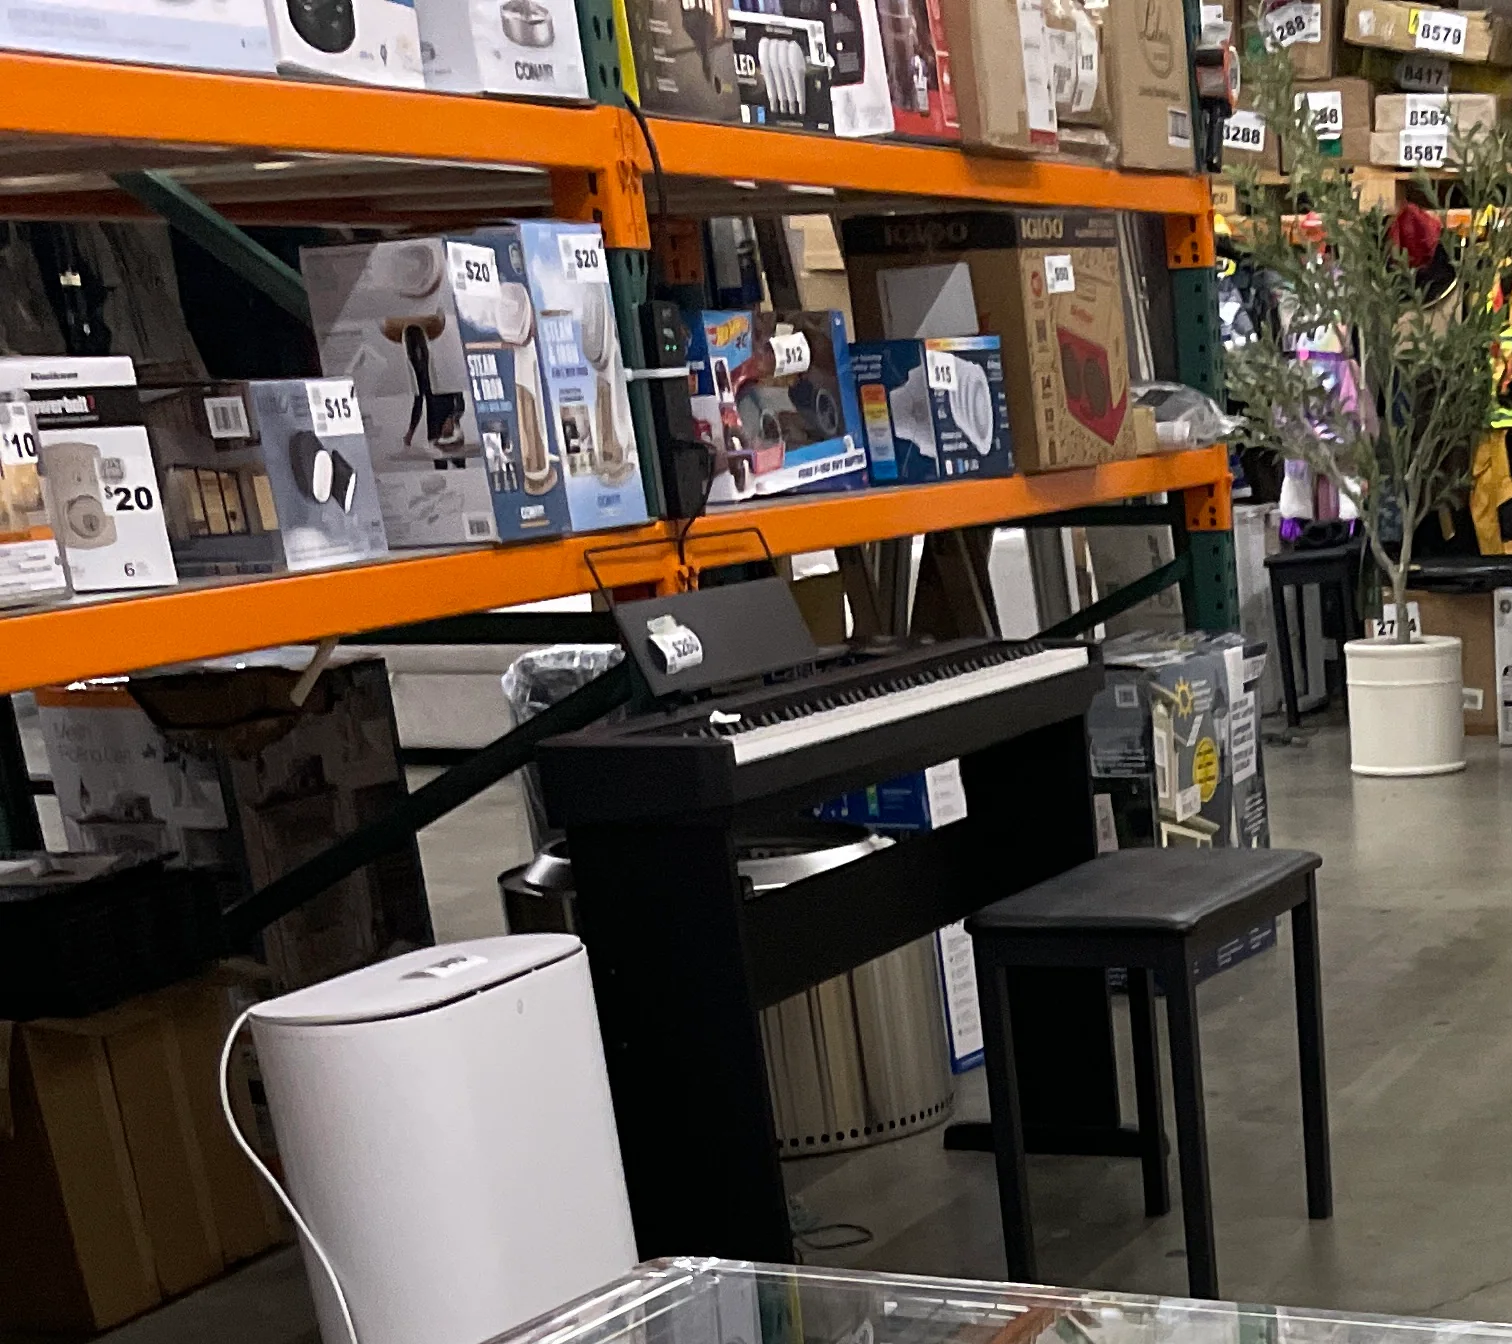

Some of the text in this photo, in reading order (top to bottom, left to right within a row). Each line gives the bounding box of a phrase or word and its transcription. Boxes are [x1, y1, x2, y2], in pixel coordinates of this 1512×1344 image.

[1276, 16, 1306, 41] 288
[1421, 23, 1462, 45] 8579
[733, 54, 756, 76] LED
[1403, 145, 1444, 162] 8587
[1021, 217, 1063, 239] IGLOO
[574, 249, 599, 270] $20
[465, 259, 491, 283] $20
[325, 398, 351, 419] $15
[3, 432, 36, 458] $10
[104, 486, 153, 511] $20
